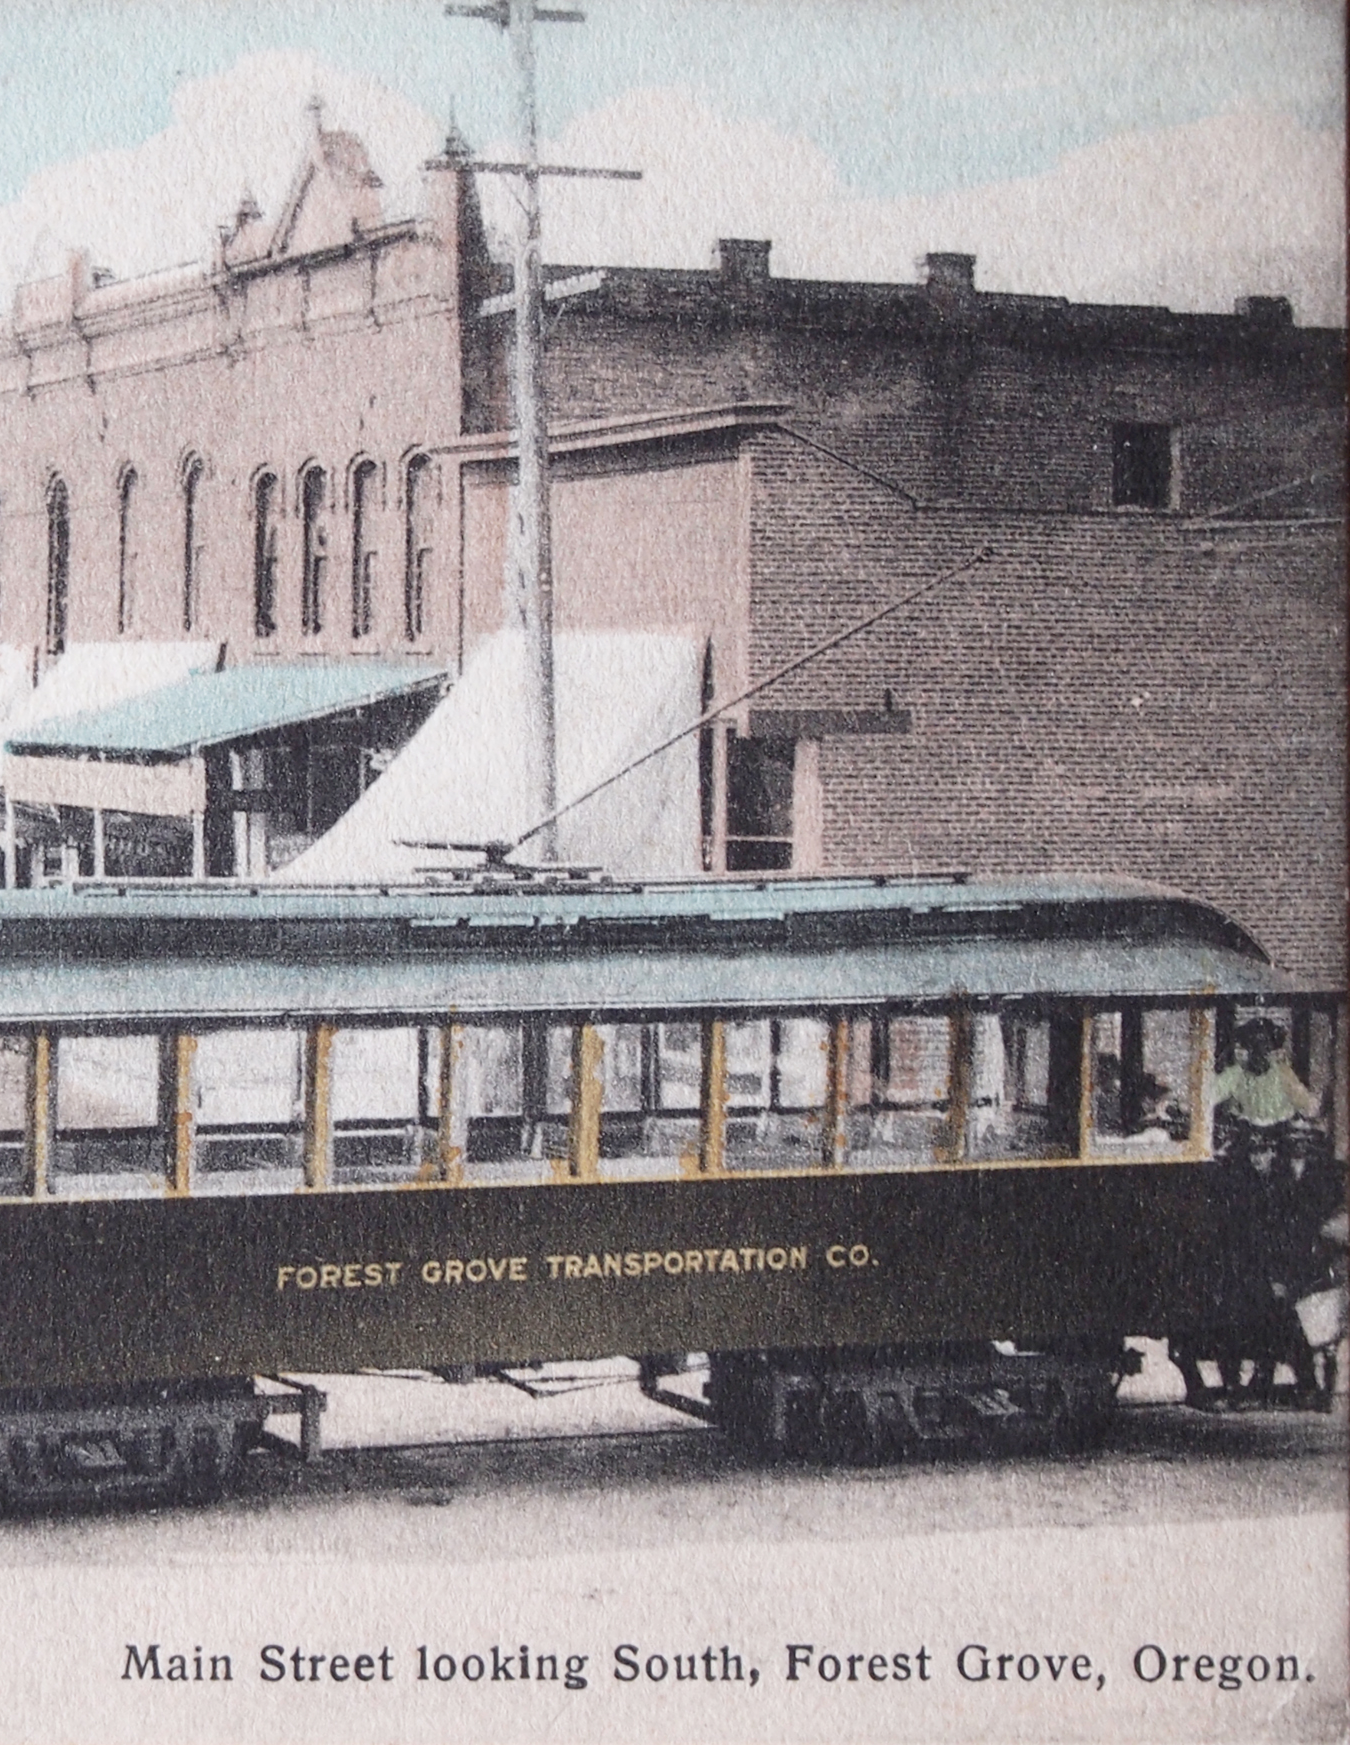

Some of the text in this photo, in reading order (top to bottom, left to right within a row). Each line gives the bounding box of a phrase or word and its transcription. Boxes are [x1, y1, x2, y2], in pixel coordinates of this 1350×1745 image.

[276, 1244, 880, 1290] FOREST GROVE TRANSPORTATION CO.
